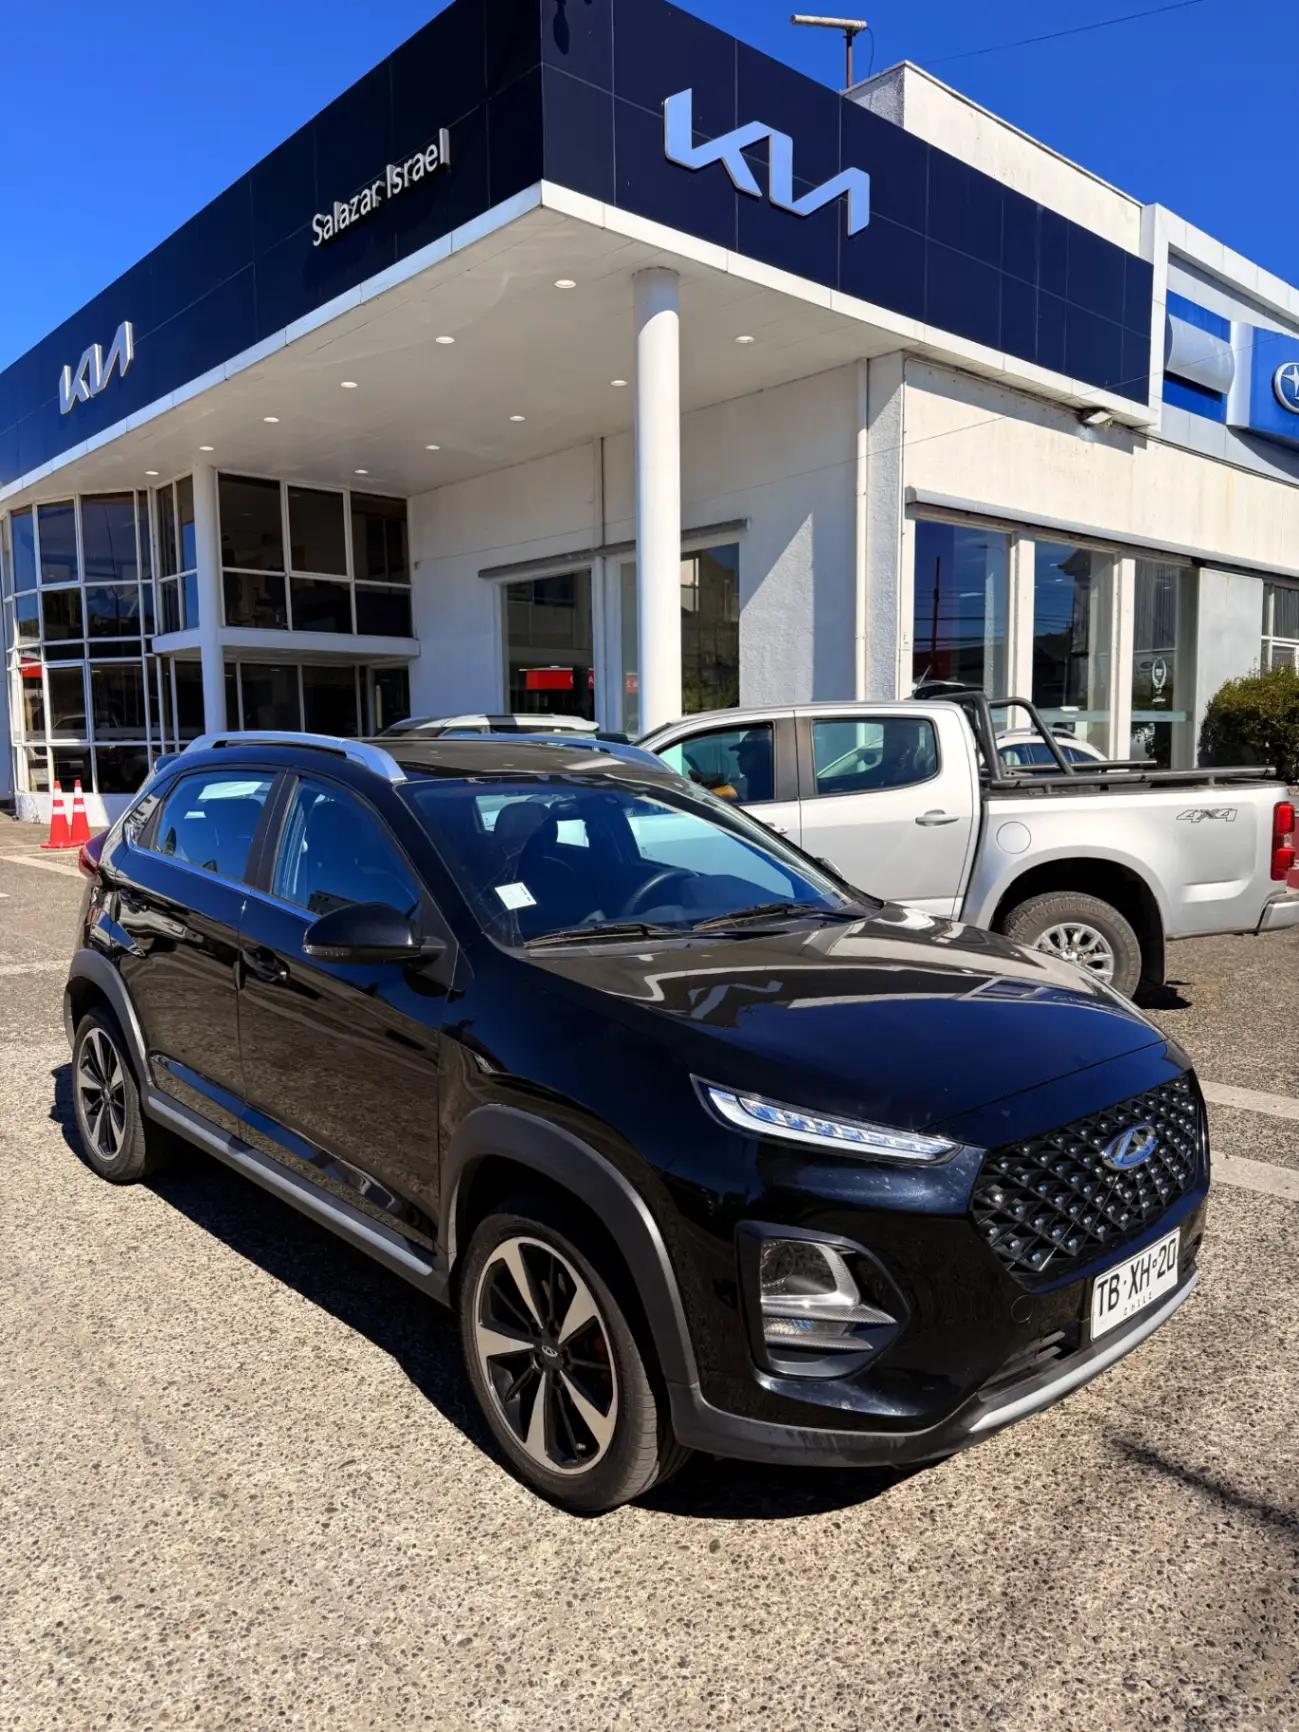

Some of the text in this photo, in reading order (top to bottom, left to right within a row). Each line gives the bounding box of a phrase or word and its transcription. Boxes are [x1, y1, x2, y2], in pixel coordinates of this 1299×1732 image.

[312, 127, 450, 247] Salazar Israel
[664, 87, 870, 237] KIA
[59, 320, 134, 415] KIA
